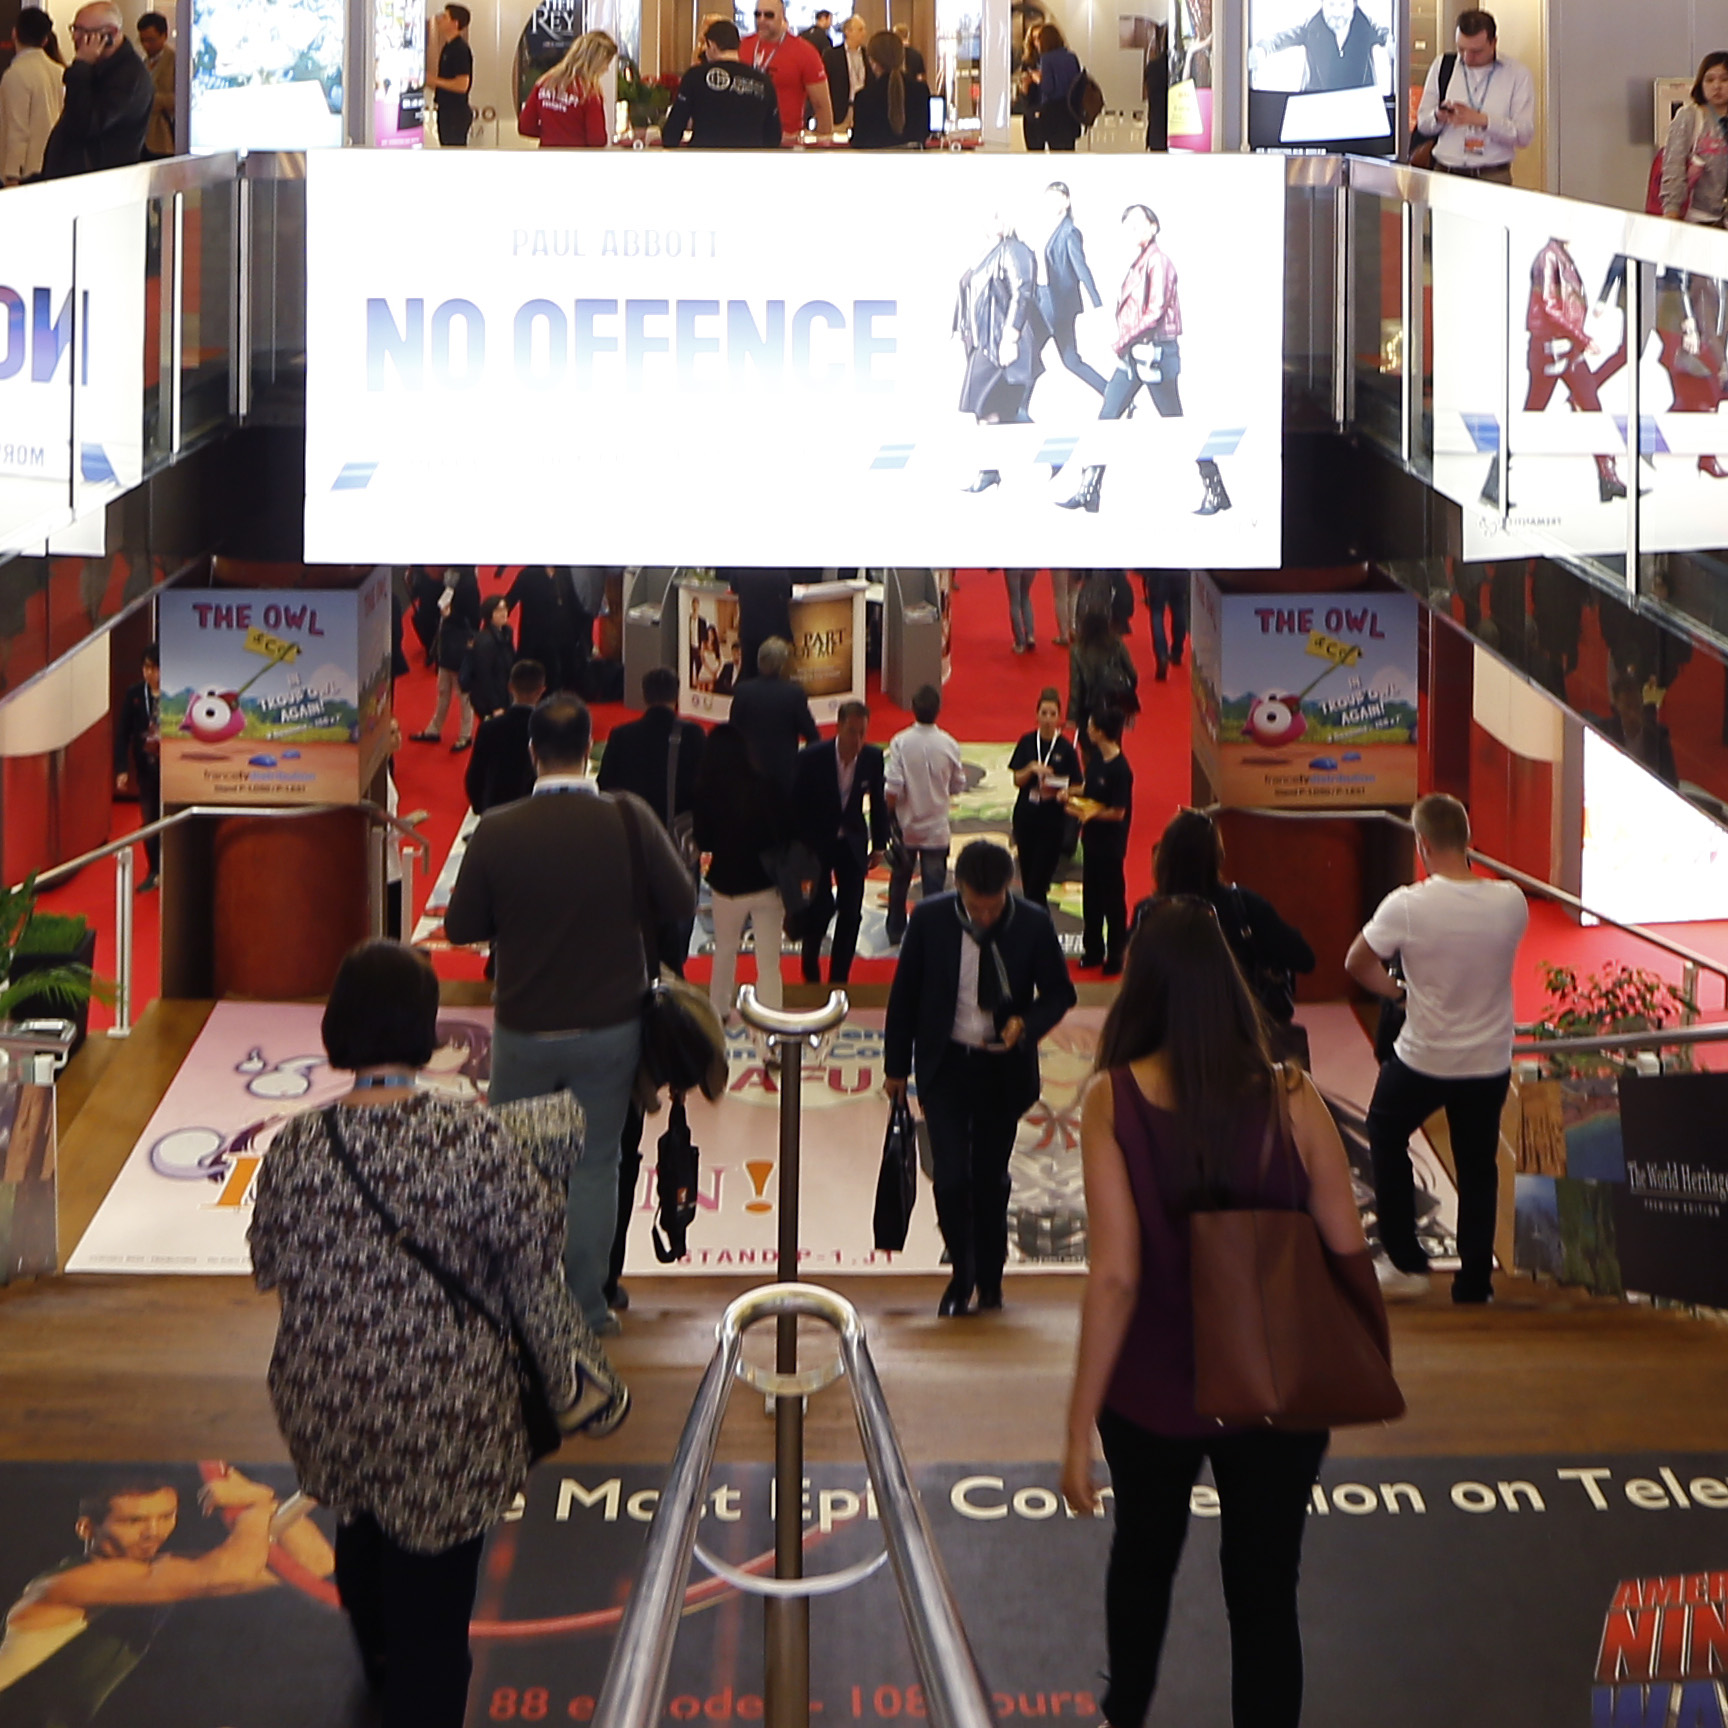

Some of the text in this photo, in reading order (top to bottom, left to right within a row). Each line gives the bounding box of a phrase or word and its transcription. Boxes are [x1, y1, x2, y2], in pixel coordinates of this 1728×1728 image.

[512, 228, 719, 259] PAUL ABBOTT
[366, 297, 898, 393] NO OFFENCE
[192, 601, 325, 636] THE OWL
[1254, 606, 1314, 634] THE
[1325, 606, 1386, 640] OWL
[802, 628, 846, 649] PART
[280, 699, 326, 724] AGAIN!
[1340, 702, 1386, 727] AGAIN!
[1627, 1160, 1646, 1190] The
[1647, 1160, 1679, 1191] World
[1449, 1478, 1547, 1514] on
[488, 1686, 550, 1720] 88
[988, 1687, 1098, 1721] ours
